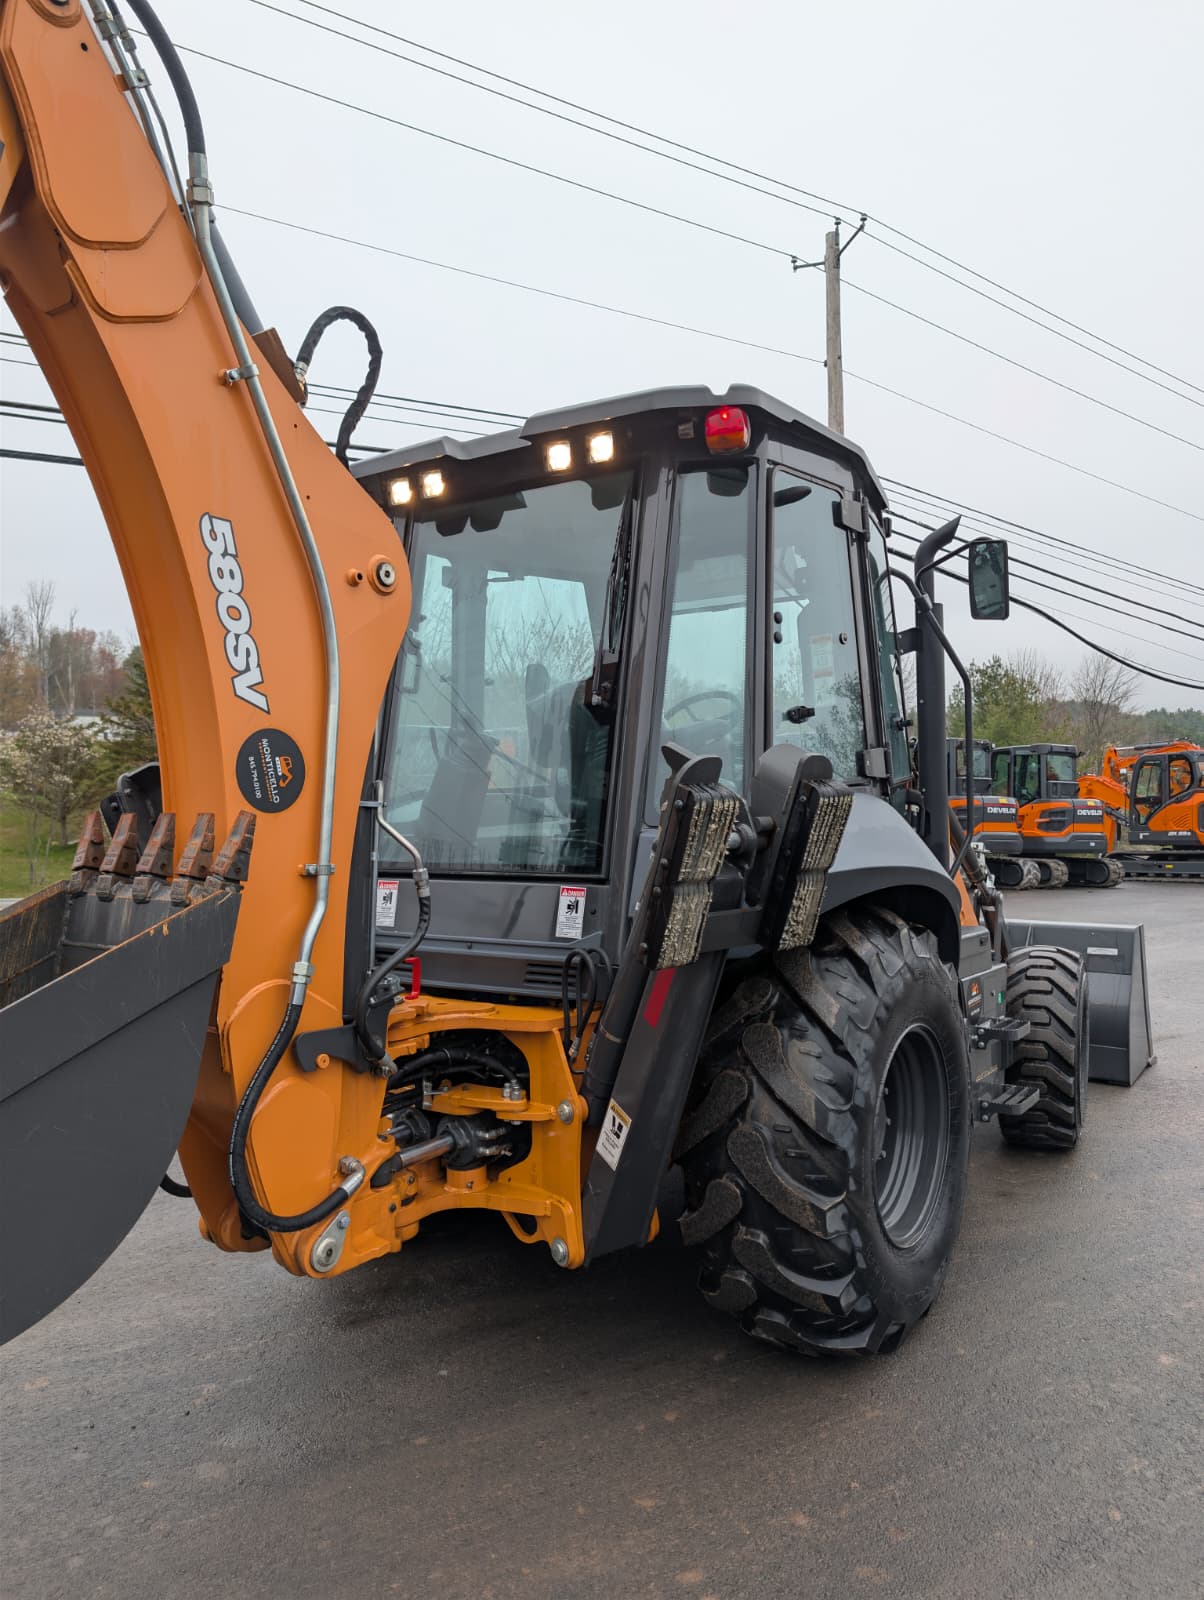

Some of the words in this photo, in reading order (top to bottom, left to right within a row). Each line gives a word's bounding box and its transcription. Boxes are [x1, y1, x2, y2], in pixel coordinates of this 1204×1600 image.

[199, 512, 271, 715] 580SV
[248, 756, 262, 799] 845.794.0100
[261, 738, 280, 803] MONTICELLO
